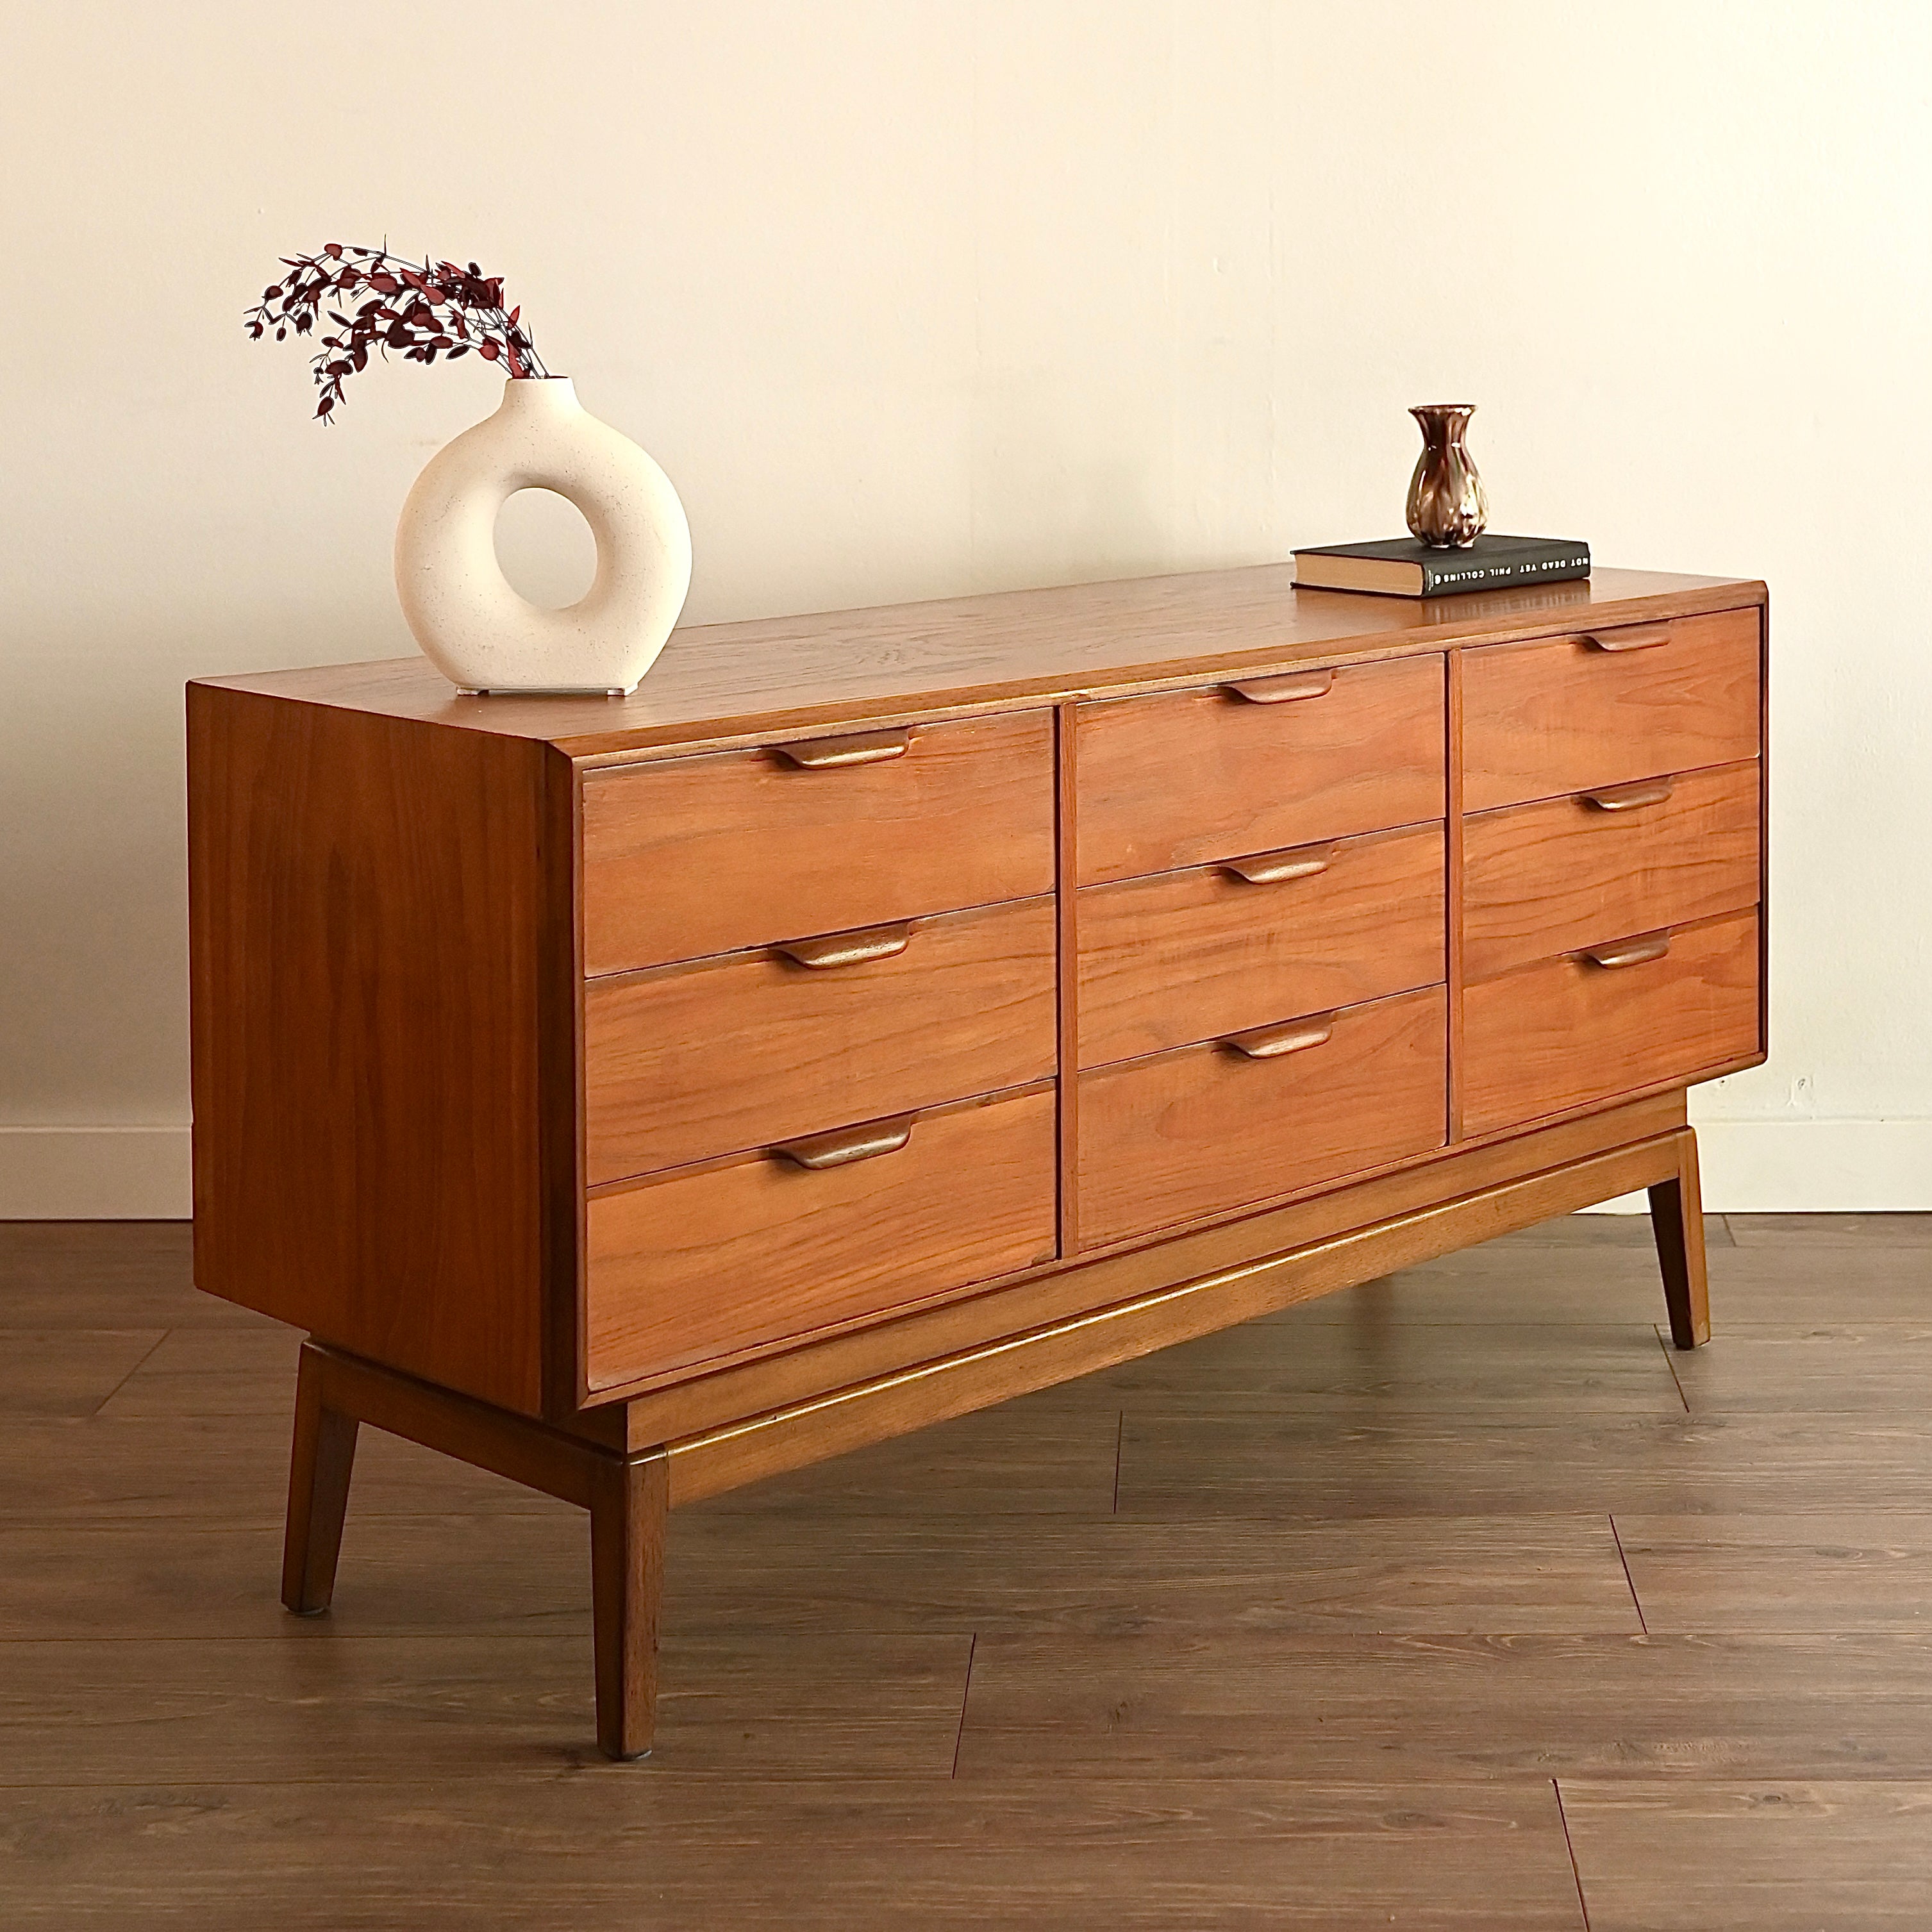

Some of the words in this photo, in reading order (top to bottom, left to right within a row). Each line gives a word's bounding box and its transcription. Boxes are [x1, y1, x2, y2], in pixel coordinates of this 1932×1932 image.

[1542, 560, 1566, 570] DEAD
[1570, 557, 1588, 567] NOT
[1490, 567, 1511, 576] PHIL
[1519, 563, 1537, 573] YET
[1444, 570, 1485, 583] COLLINS
